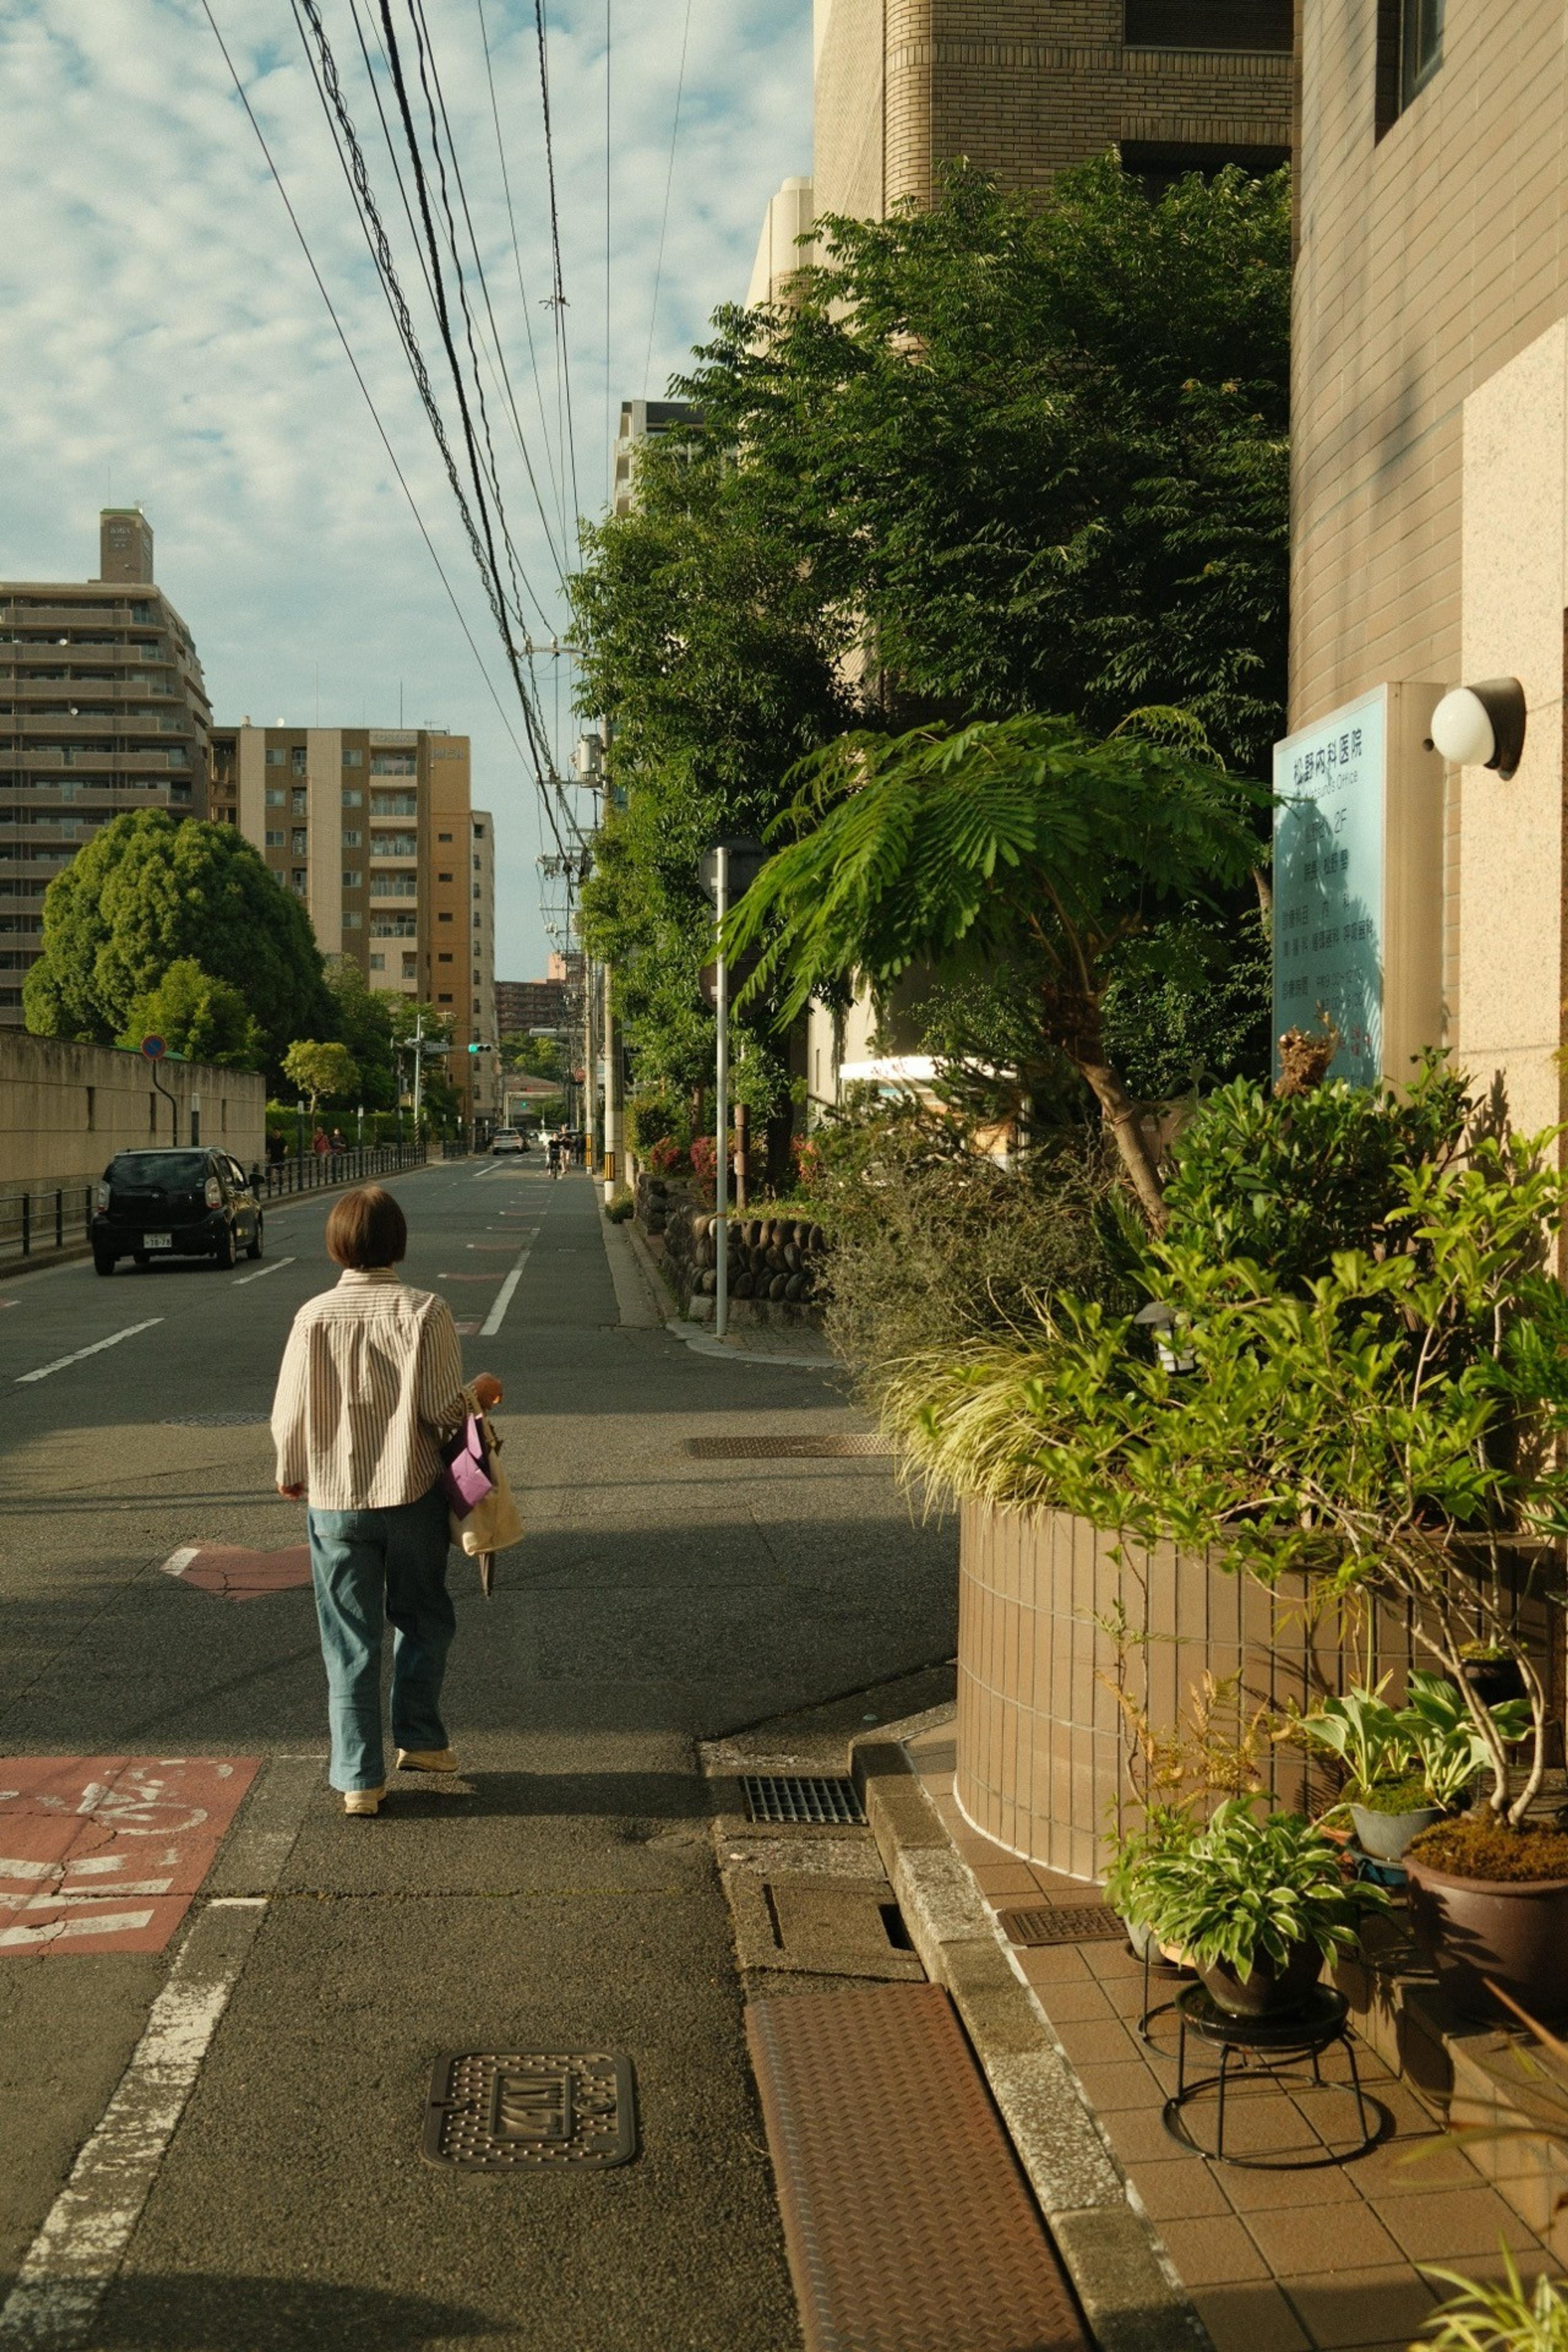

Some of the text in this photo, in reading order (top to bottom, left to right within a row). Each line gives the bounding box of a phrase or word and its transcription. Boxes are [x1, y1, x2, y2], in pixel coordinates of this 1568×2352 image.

[1294, 728, 1361, 787] 松野内科医院
[1337, 770, 1358, 790] Office
[1334, 808, 1347, 833] 2F
[1282, 905, 1308, 931] 診療科目
[1343, 918, 1373, 944] 呼吸器科
[1282, 976, 1308, 1000] 診療時間
